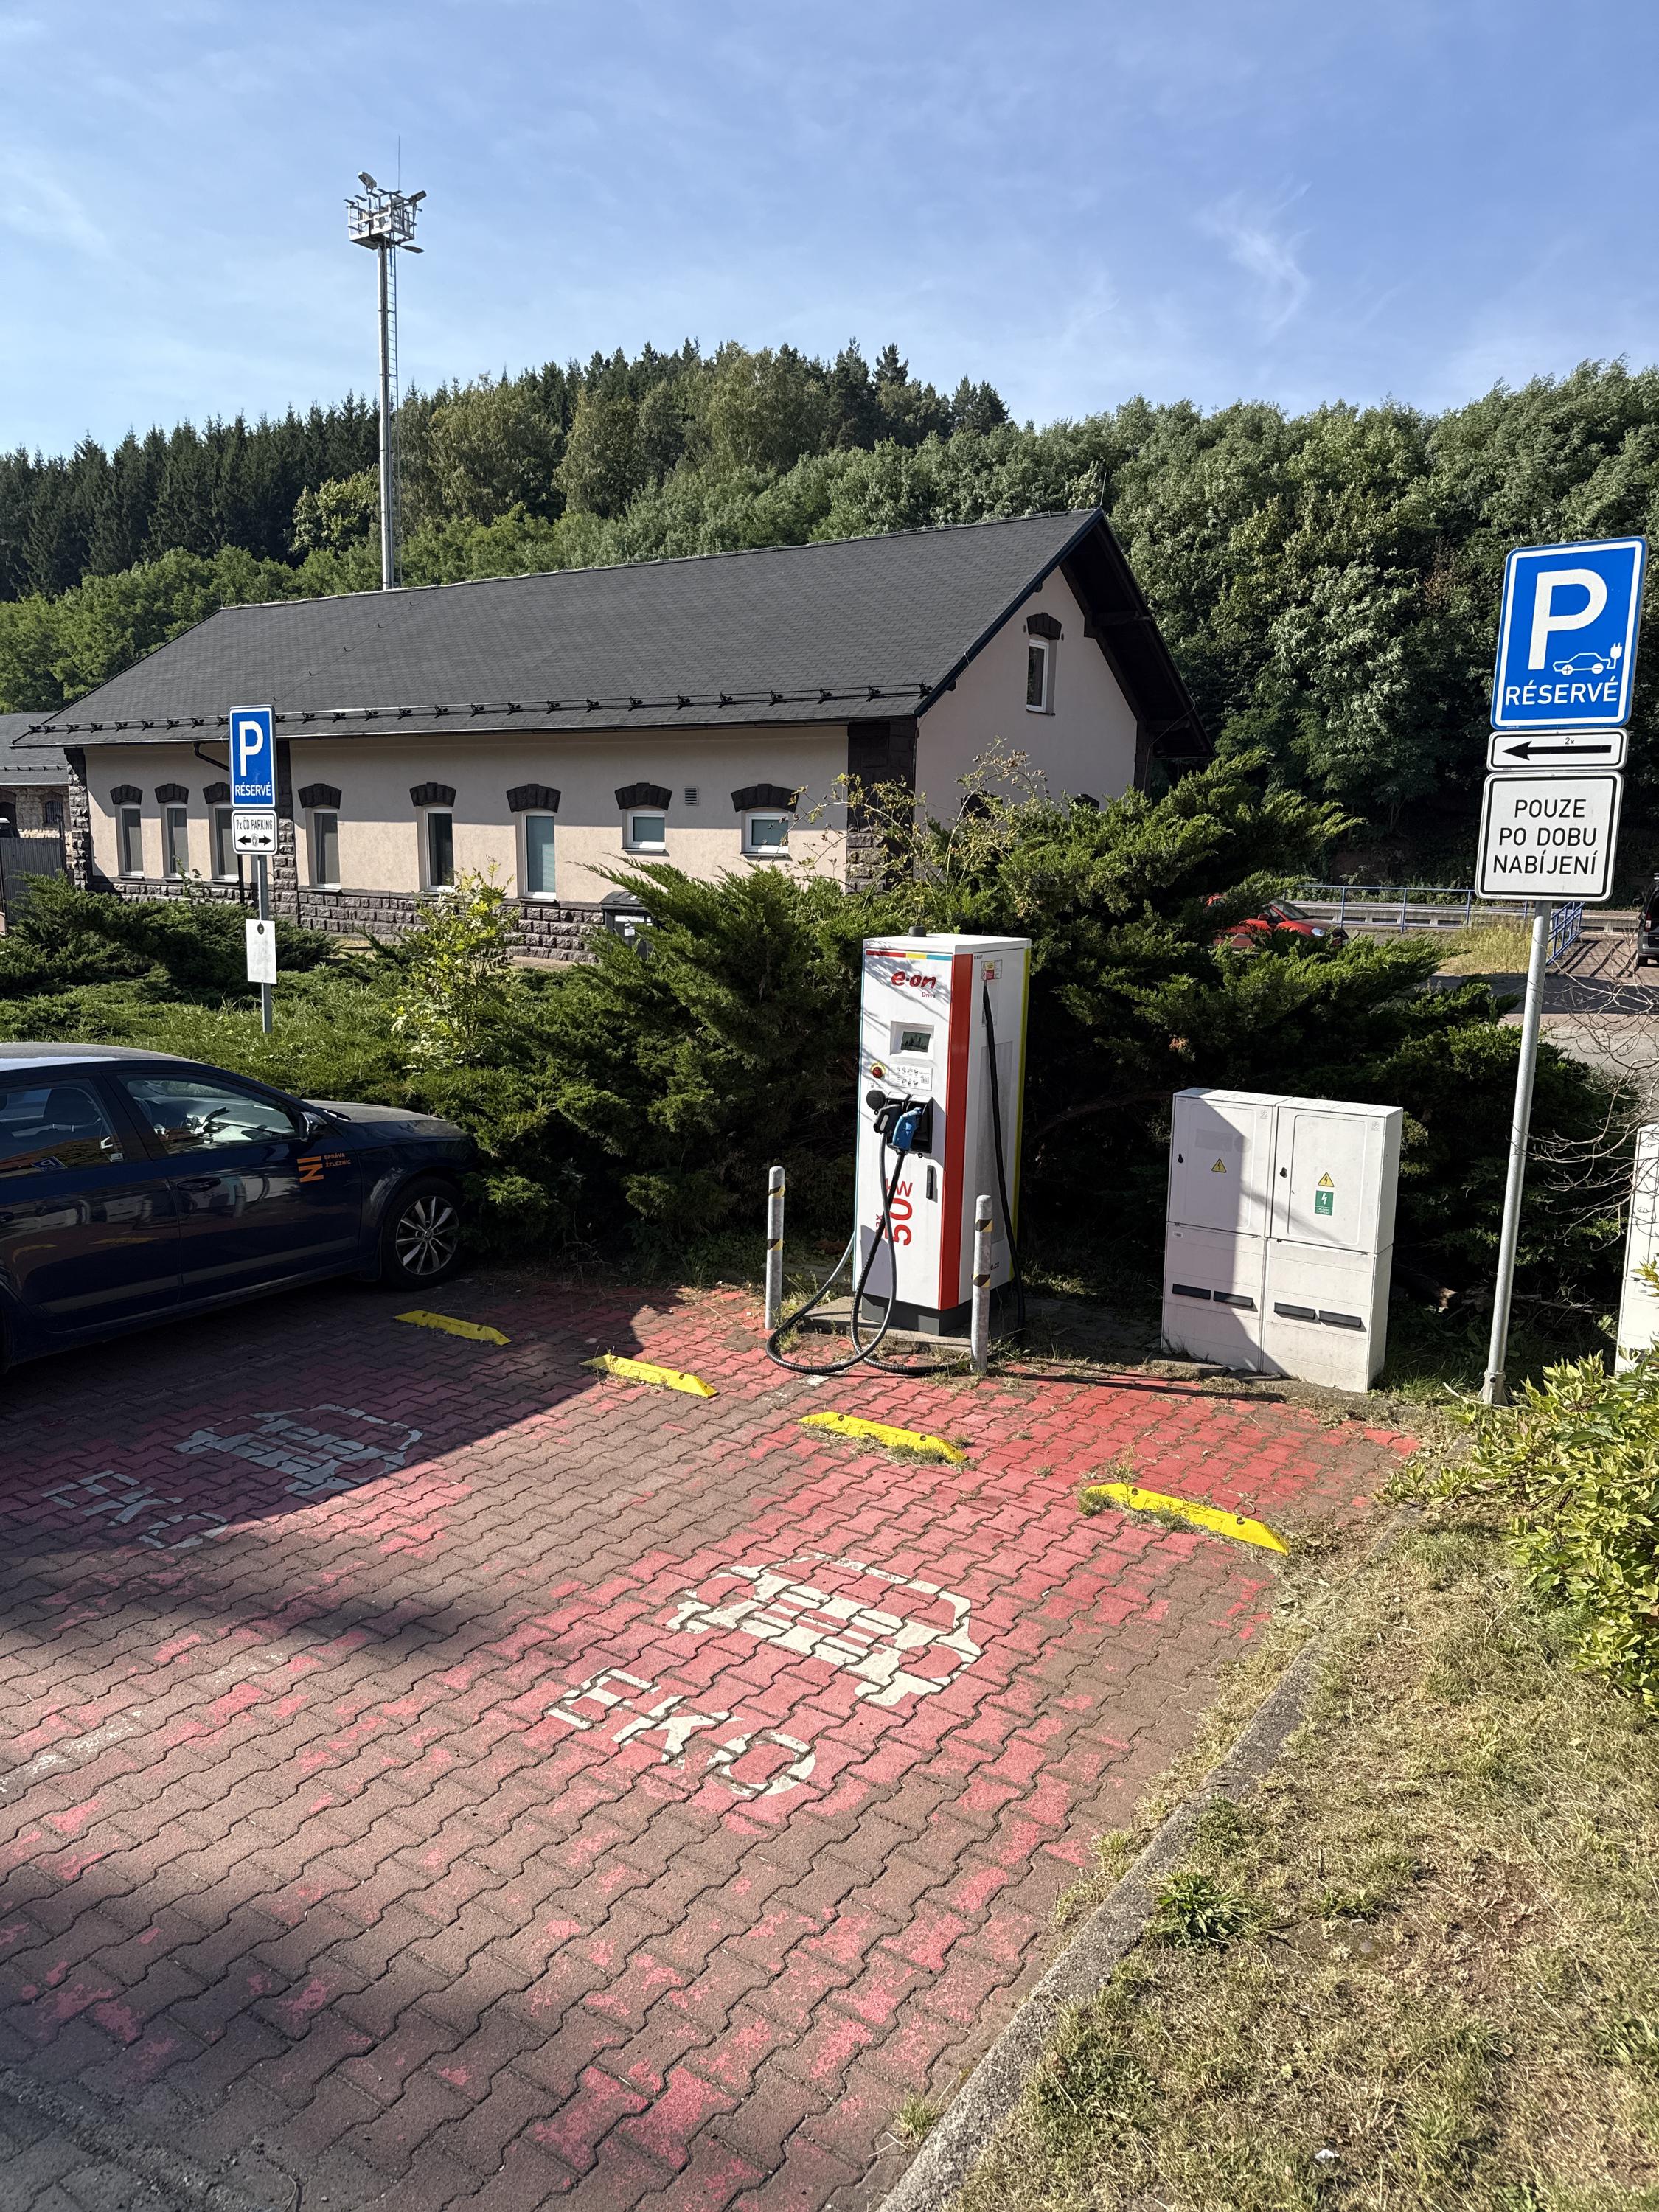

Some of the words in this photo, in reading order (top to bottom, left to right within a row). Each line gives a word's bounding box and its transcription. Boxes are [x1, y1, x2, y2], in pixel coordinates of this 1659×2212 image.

[1528, 568, 1607, 670] P
[1505, 675, 1618, 706] RÉSERVÉ
[239, 720, 263, 776] P
[1565, 737, 1575, 745] 2x
[235, 782, 271, 796] RÉSERVÉ
[1514, 799, 1587, 818] POUZE
[236, 819, 243, 830] 7x
[243, 817, 250, 830] ČD
[251, 819, 273, 830] PARKING
[1499, 827, 1526, 846] PO
[1537, 827, 1597, 846] DOBU
[1493, 850, 1597, 875] NABÍJENÍ
[41, 1470, 228, 1549] EKO
[549, 1666, 816, 1796] EKO
